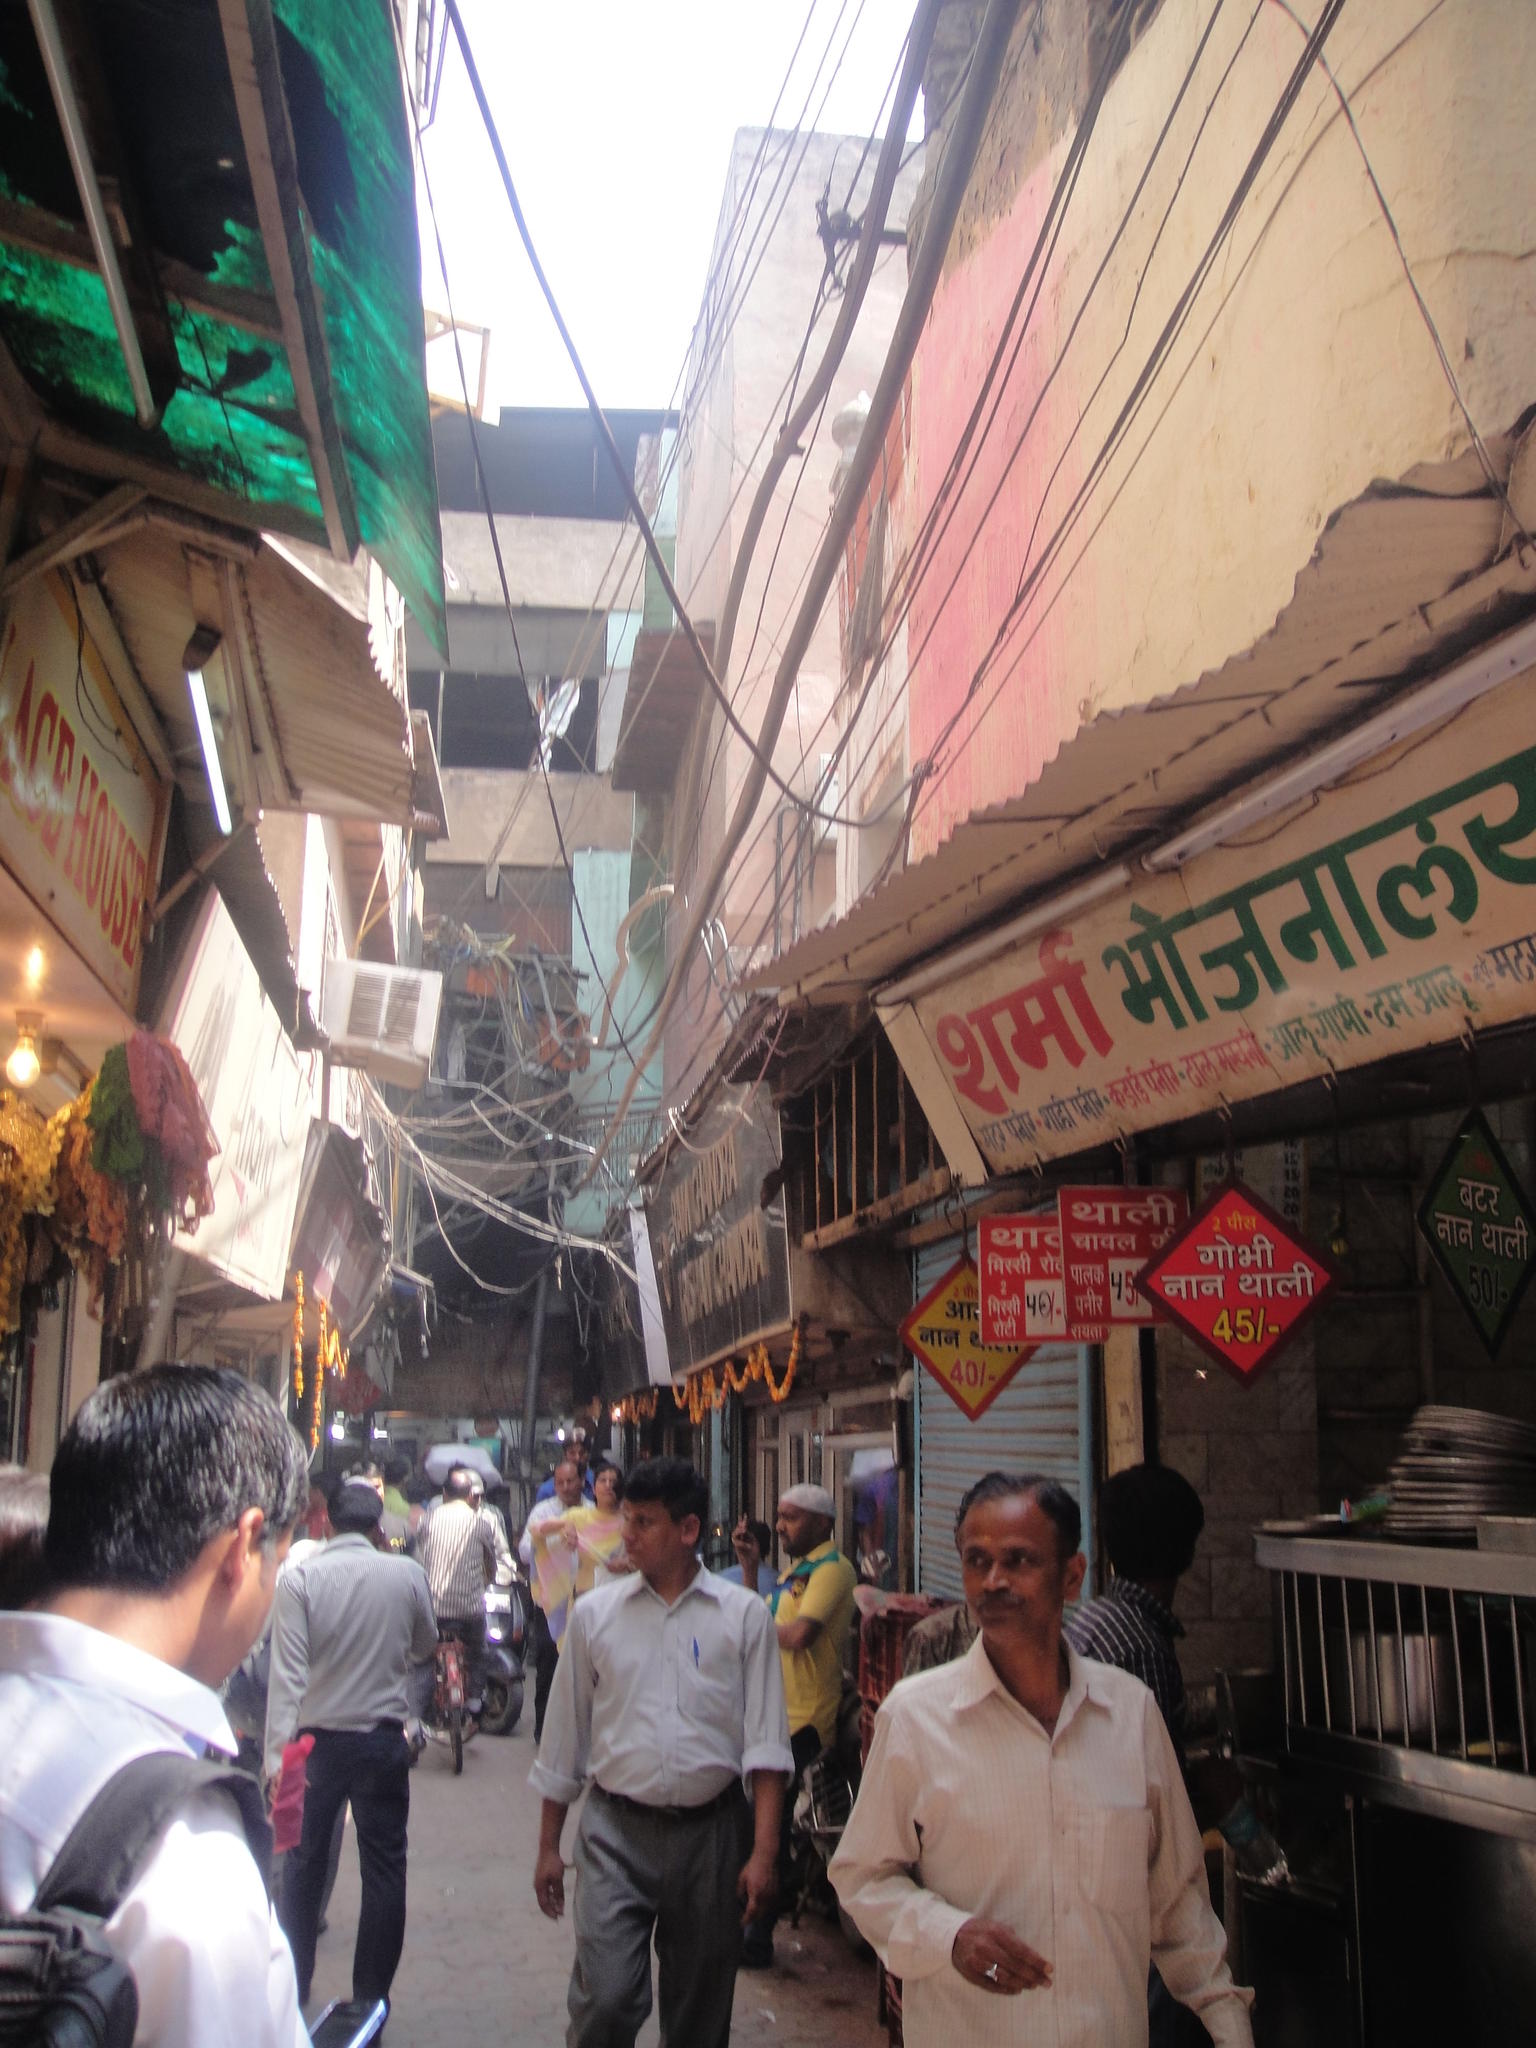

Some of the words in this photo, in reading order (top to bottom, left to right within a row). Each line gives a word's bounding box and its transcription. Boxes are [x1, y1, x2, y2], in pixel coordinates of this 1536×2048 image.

[0, 623, 77, 858] ACE
[63, 754, 147, 969] HOUSE
[936, 927, 1115, 1116] शर्मा
[1071, 1194, 1176, 1226] थाली
[1458, 1177, 1500, 1216] बटर
[1070, 1233, 1136, 1251] चावल
[1197, 1233, 1274, 1270] गोभी
[1435, 1211, 1473, 1251] नान
[1482, 1215, 1529, 1261] थाली
[1070, 1263, 1105, 1286] पालक
[1161, 1274, 1225, 1300] नान
[1239, 1261, 1314, 1298] थाली
[1075, 1287, 1104, 1317] पनीर
[918, 1326, 960, 1349] नान
[1212, 1307, 1280, 1343] 45/-
[950, 1359, 997, 1388] 40/-
